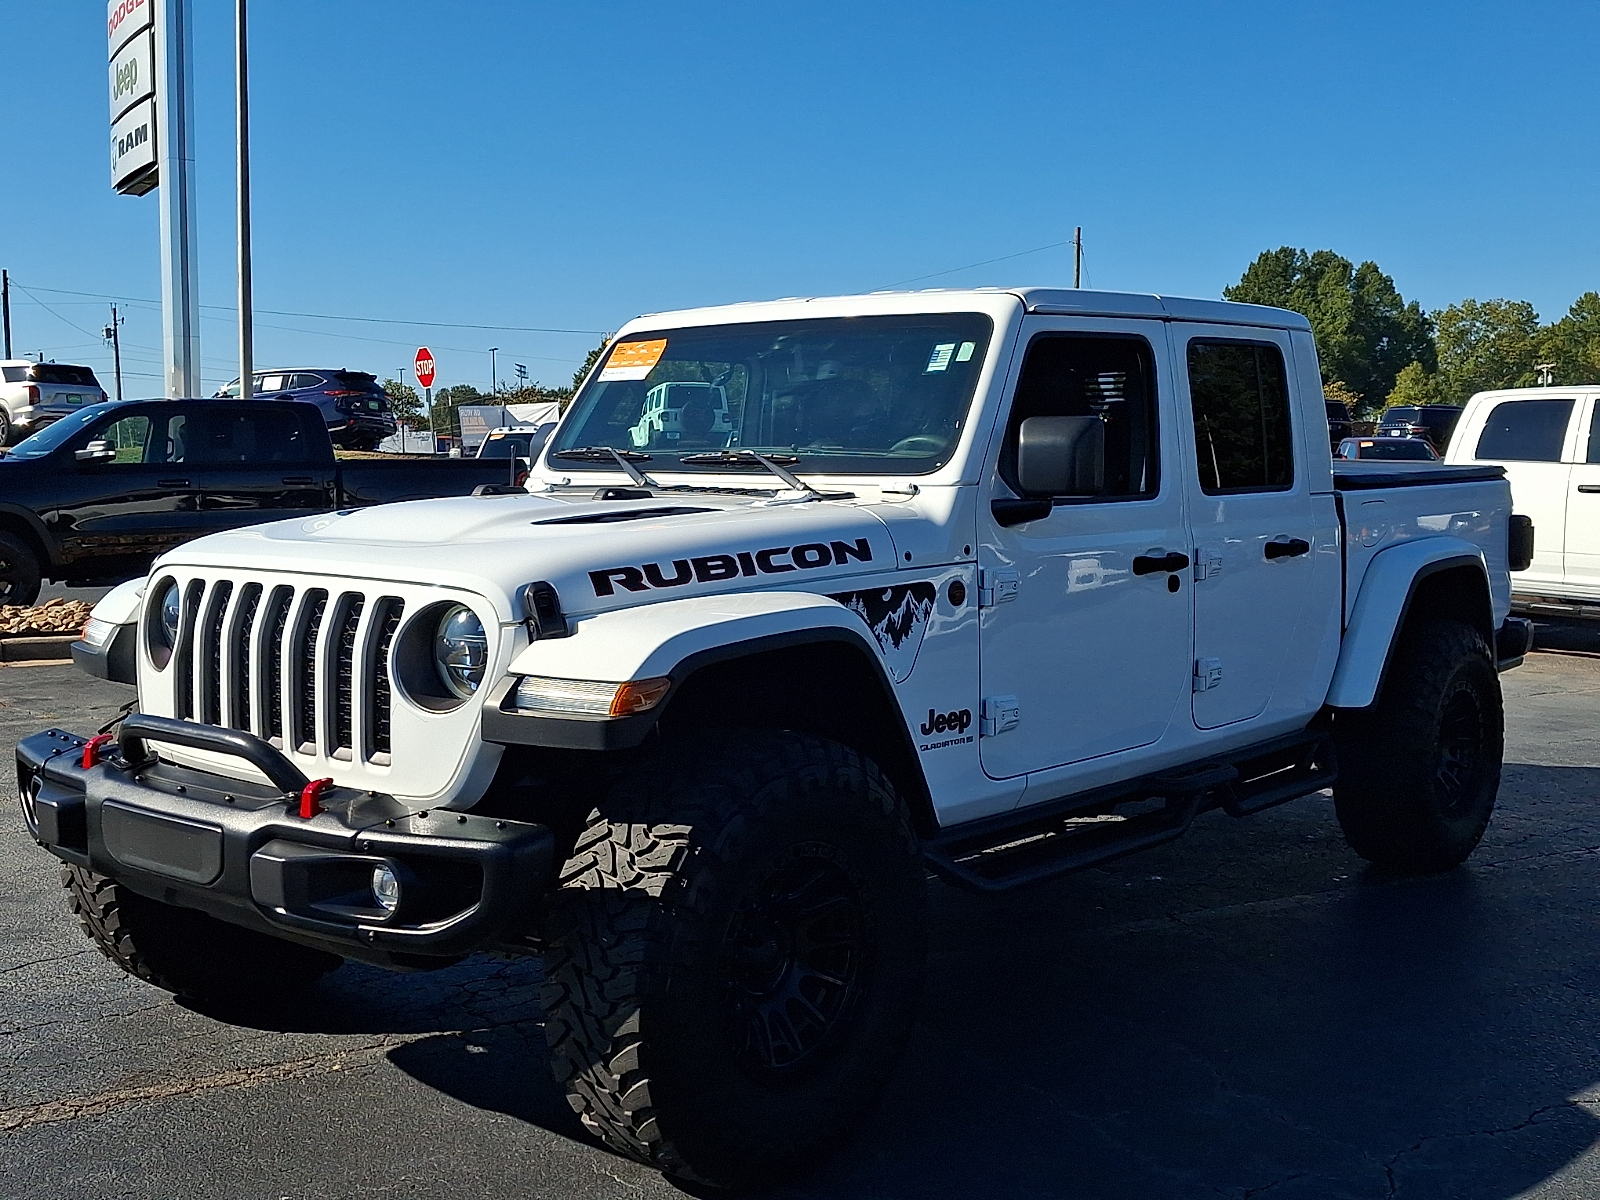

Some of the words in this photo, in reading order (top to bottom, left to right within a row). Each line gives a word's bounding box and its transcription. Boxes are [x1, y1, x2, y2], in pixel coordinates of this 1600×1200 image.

[113, 57, 138, 101] Jeep
[118, 123, 148, 159] RAM
[416, 359, 434, 377] STOP
[588, 537, 873, 597] RUBICON
[920, 708, 972, 736] Jeep
[919, 736, 966, 752] GLADIATOR
